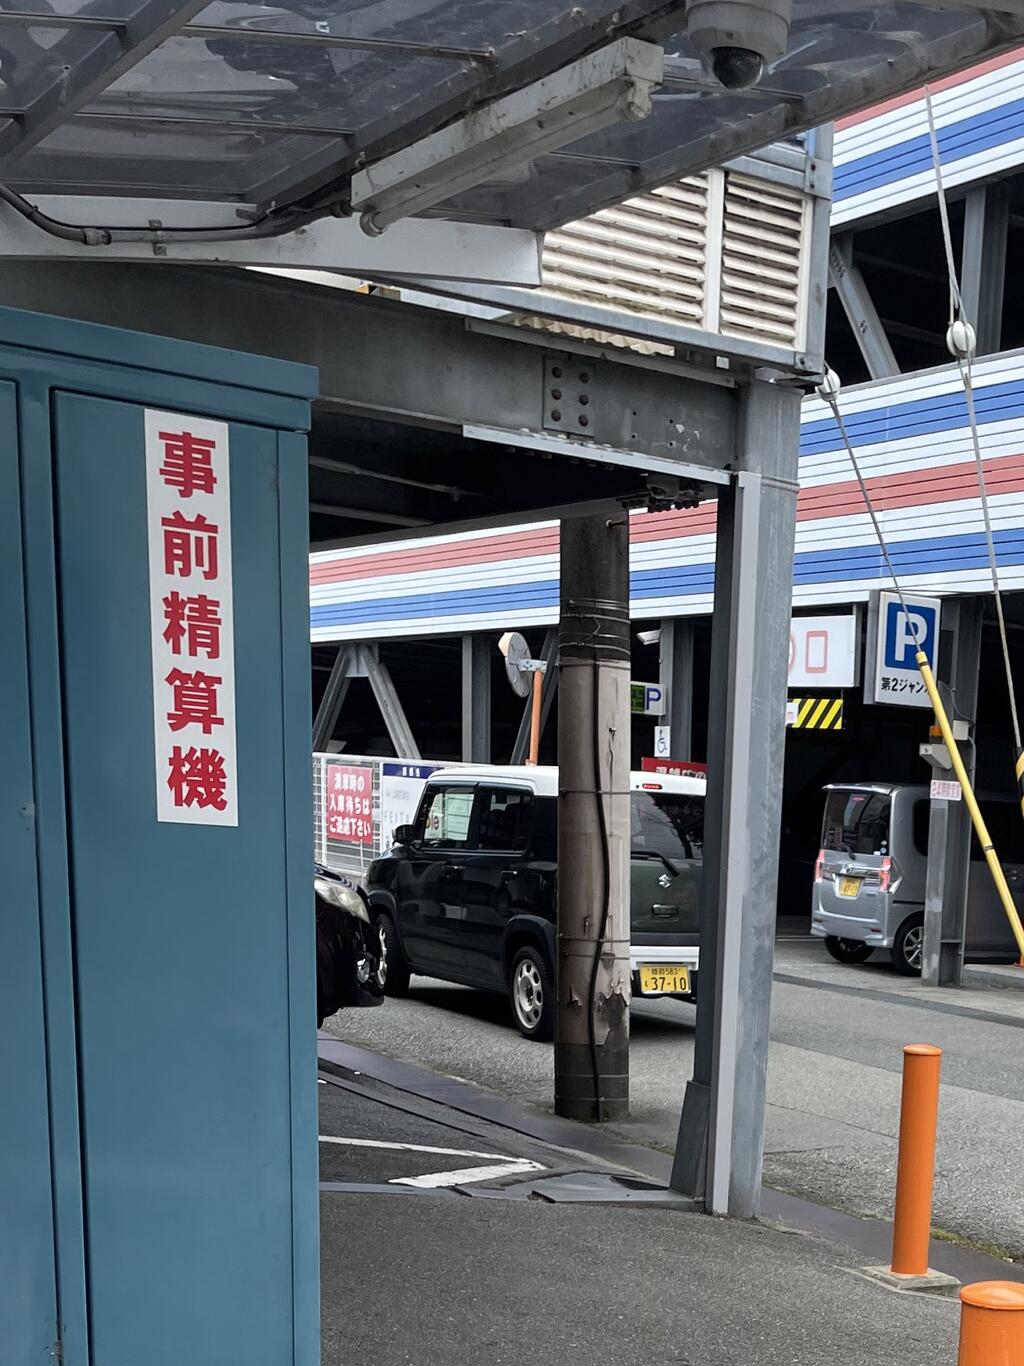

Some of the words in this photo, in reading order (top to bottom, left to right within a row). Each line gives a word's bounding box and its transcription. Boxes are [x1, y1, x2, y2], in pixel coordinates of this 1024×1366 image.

[158, 431, 228, 811] 事前精算機
[894, 611, 928, 662] P
[881, 676, 928, 693] 第2ジャン
[646, 687, 661, 710] P
[329, 793, 370, 815] 入庫待ちは
[329, 816, 371, 837] ご遠慮下さい
[651, 977, 687, 991] 37-10
